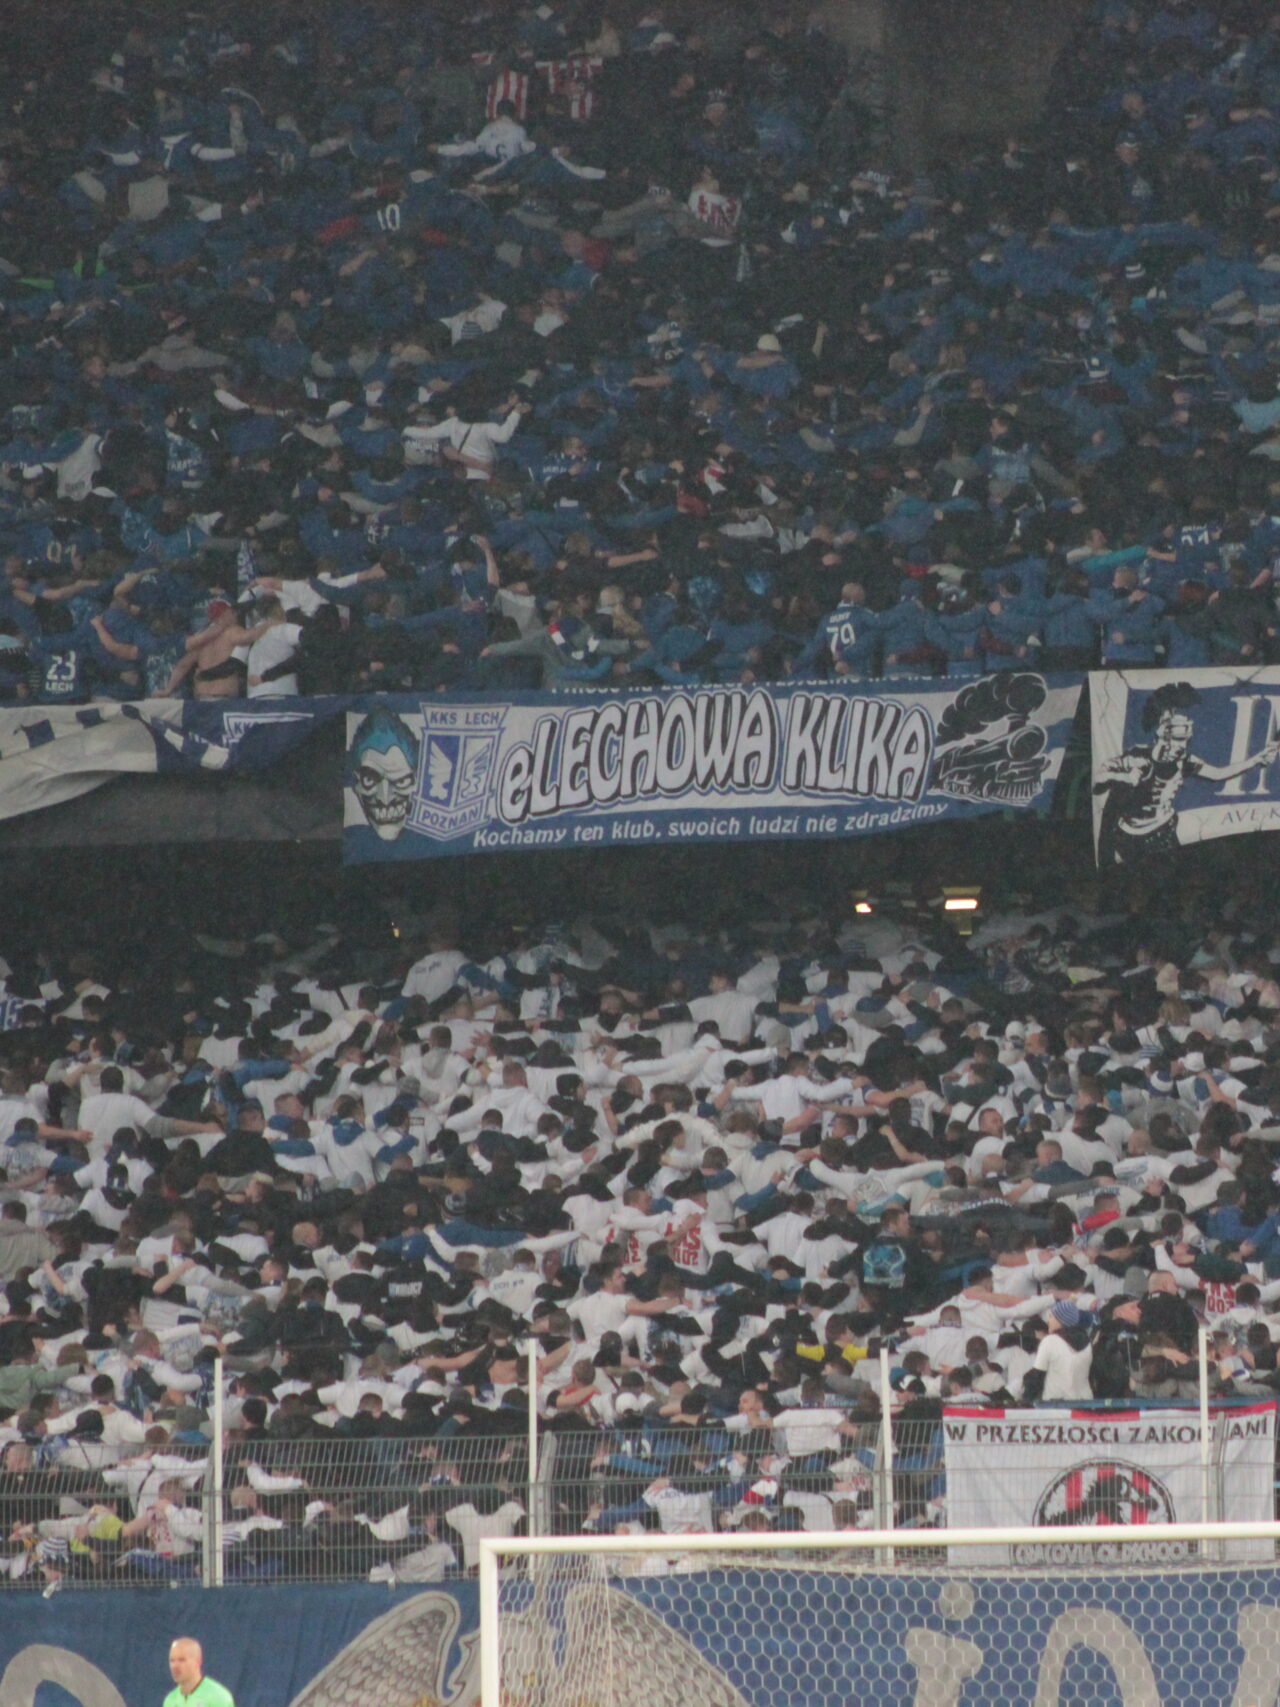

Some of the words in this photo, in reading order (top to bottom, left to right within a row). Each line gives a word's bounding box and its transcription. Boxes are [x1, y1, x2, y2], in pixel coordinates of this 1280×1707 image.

[430, 711, 457, 725] KKS
[465, 711, 500, 725] LECH
[782, 692, 934, 802] KLIKA
[473, 827, 567, 848] Kochamy
[574, 824, 603, 842] ten
[668, 817, 741, 837] swoich
[749, 815, 799, 836] ludzi
[805, 815, 838, 833] nie
[844, 802, 949, 831] zdradzimy
[1221, 807, 1262, 825] AVE
[943, 1423, 967, 1442] W
[975, 1421, 1119, 1444] PRZESZŁOŚCI
